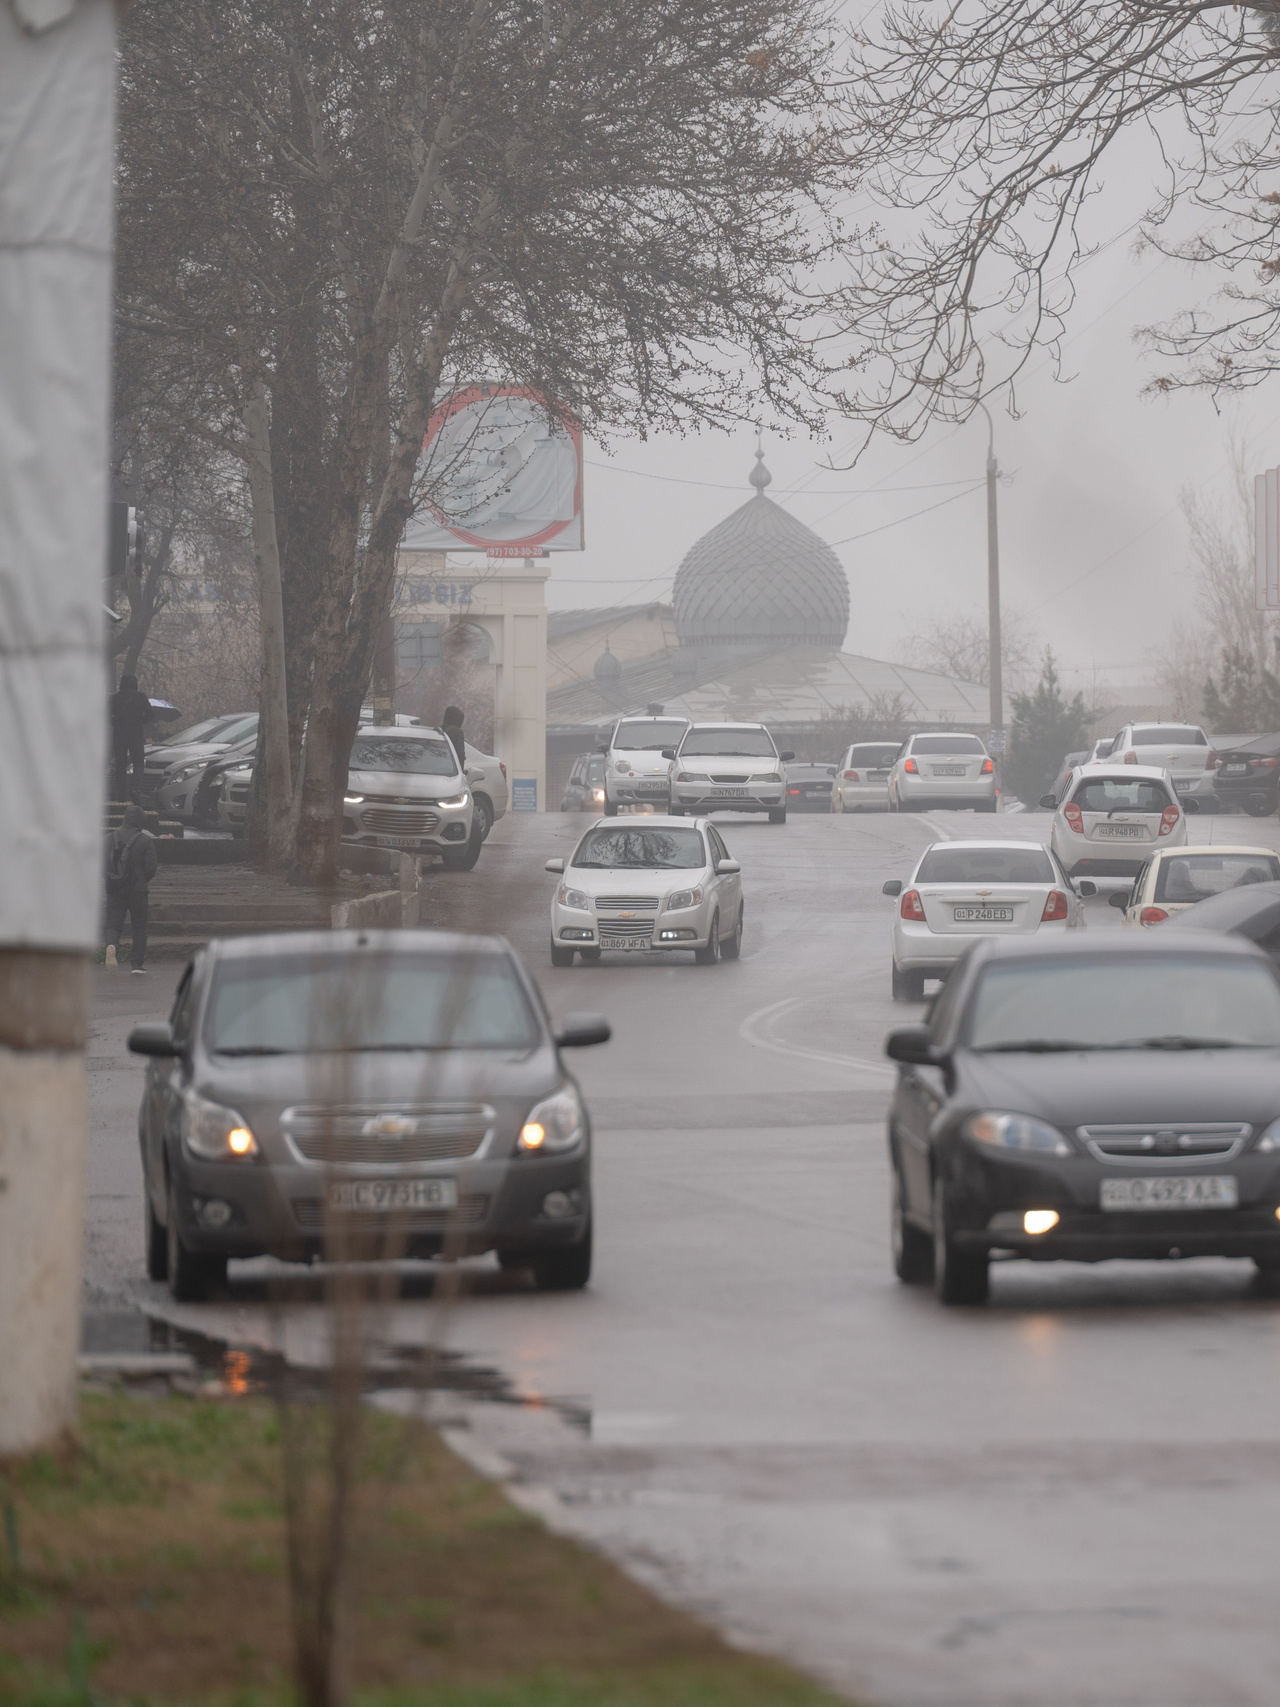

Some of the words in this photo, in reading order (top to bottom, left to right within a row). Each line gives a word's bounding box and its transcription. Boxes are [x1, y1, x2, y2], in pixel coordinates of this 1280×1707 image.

[487, 546, 502, 557] (97)
[504, 546, 543, 556] 703-30-20
[394, 582, 473, 604] LIBSIZ
[610, 939, 626, 948] 869
[628, 939, 646, 948] WFA
